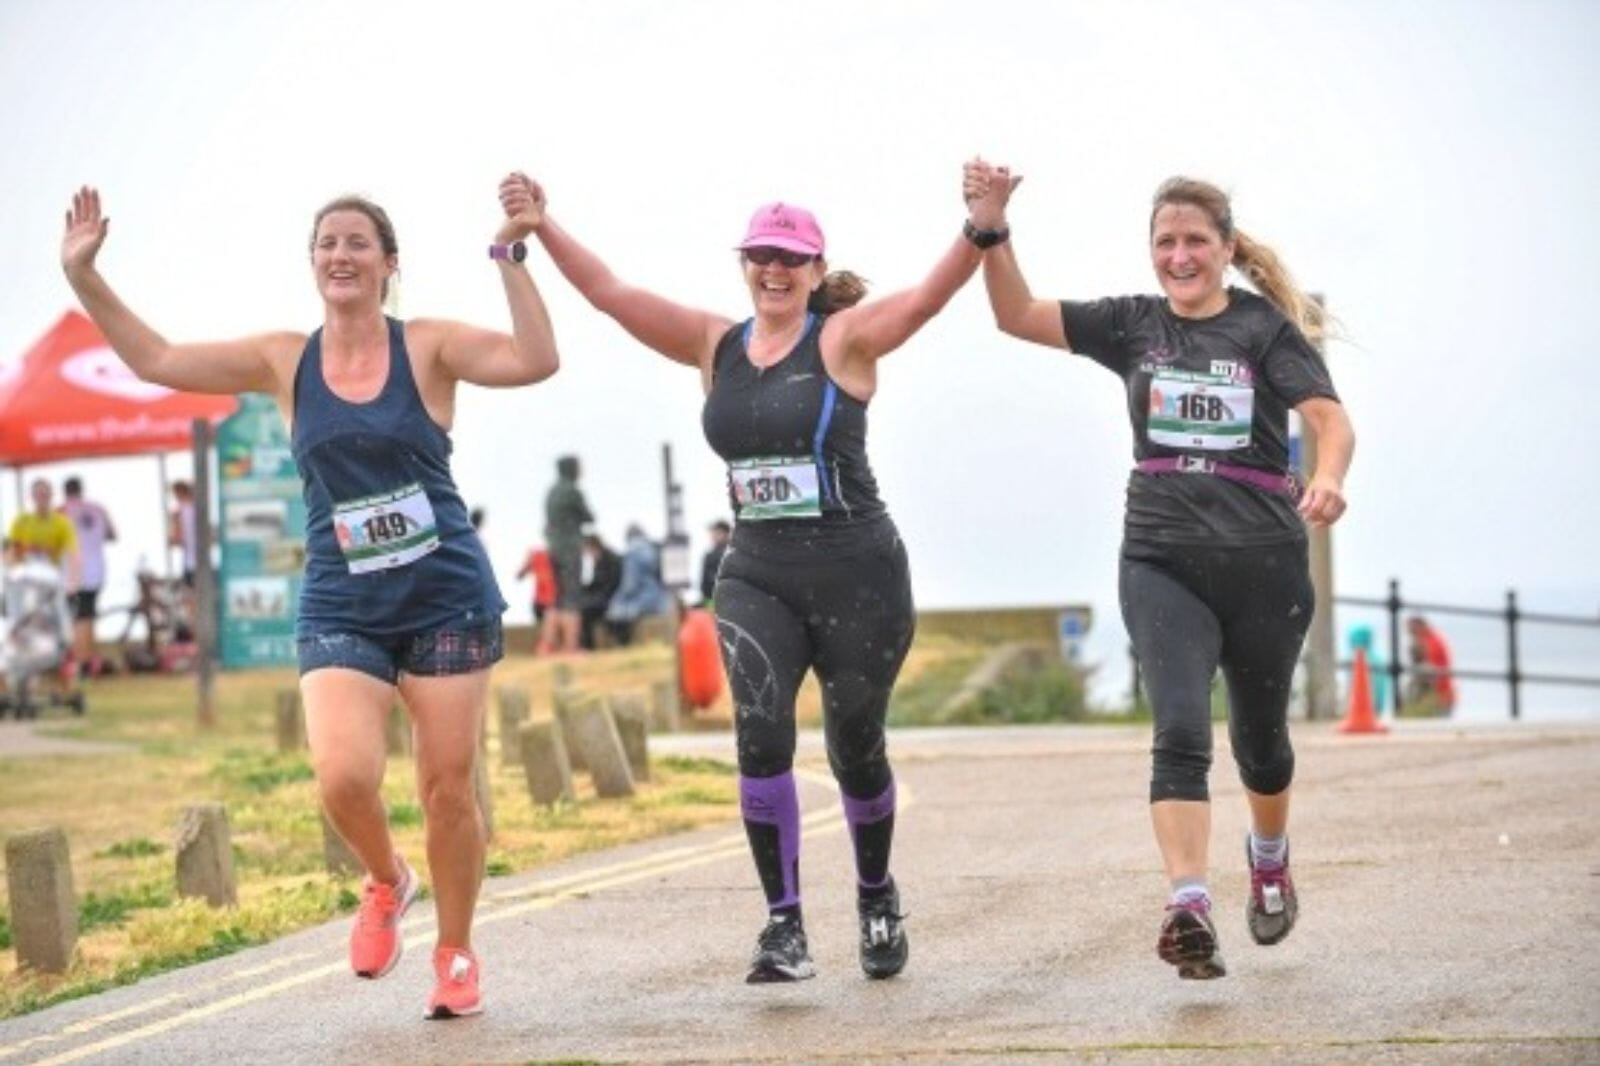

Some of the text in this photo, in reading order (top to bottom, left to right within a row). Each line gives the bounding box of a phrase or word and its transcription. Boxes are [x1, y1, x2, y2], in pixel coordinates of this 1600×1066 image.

[1176, 393, 1223, 421] 168
[746, 476, 790, 502] 130
[363, 512, 407, 543] 149
